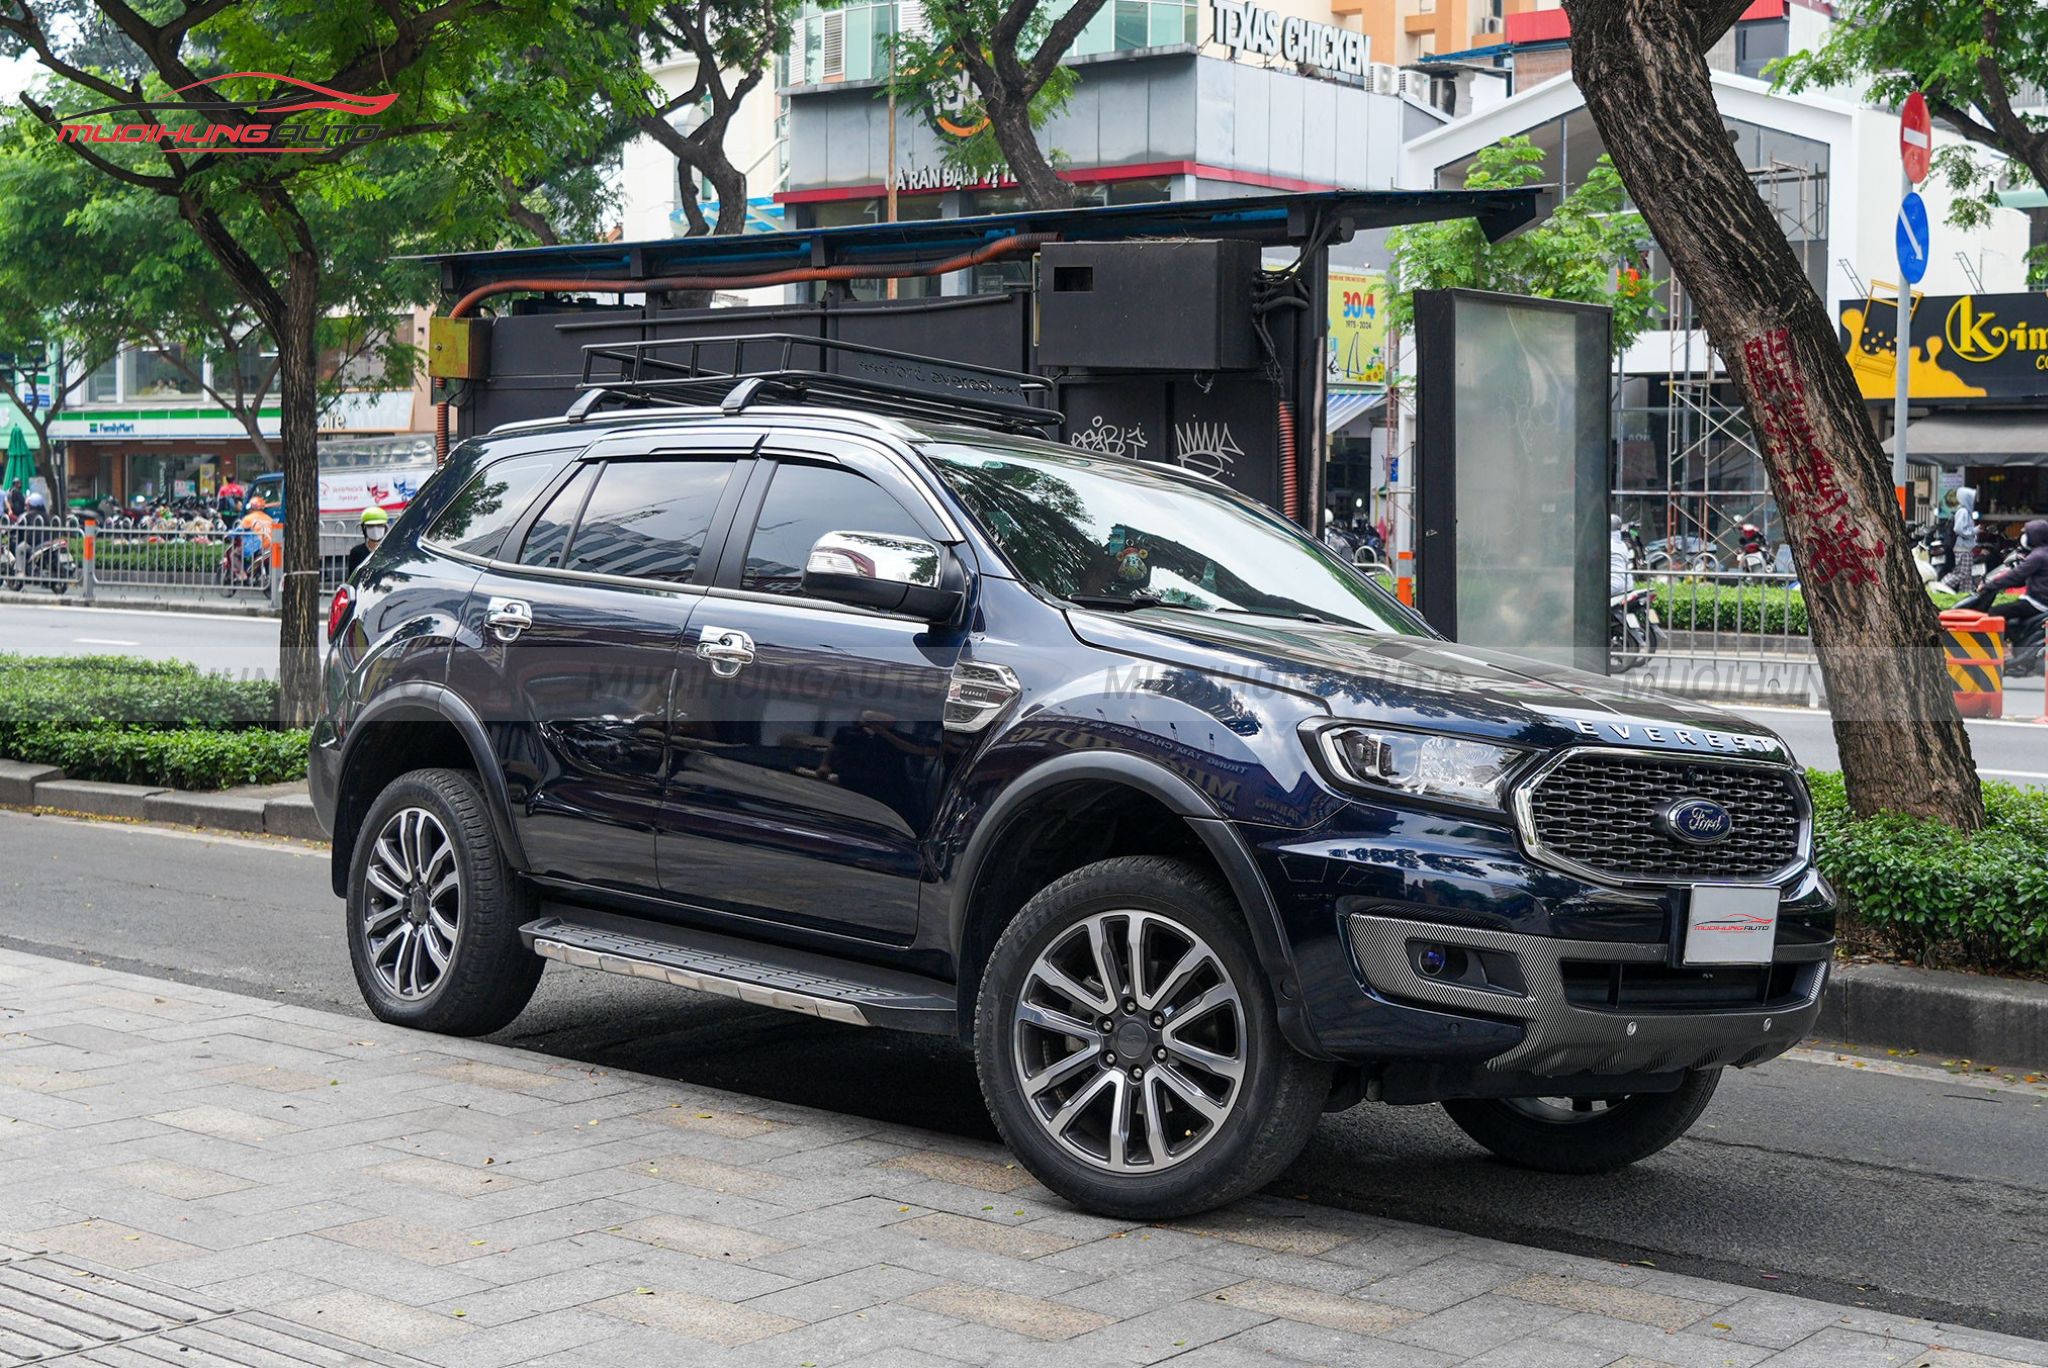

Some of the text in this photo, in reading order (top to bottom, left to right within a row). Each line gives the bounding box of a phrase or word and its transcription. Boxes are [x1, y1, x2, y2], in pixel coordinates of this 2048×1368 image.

[1210, 1, 1371, 77] TEXAS CHICKEN
[100, 423, 134, 434] FamilyMart
[1574, 719, 1770, 750] EVEREST
[1688, 807, 1723, 832] Ford
